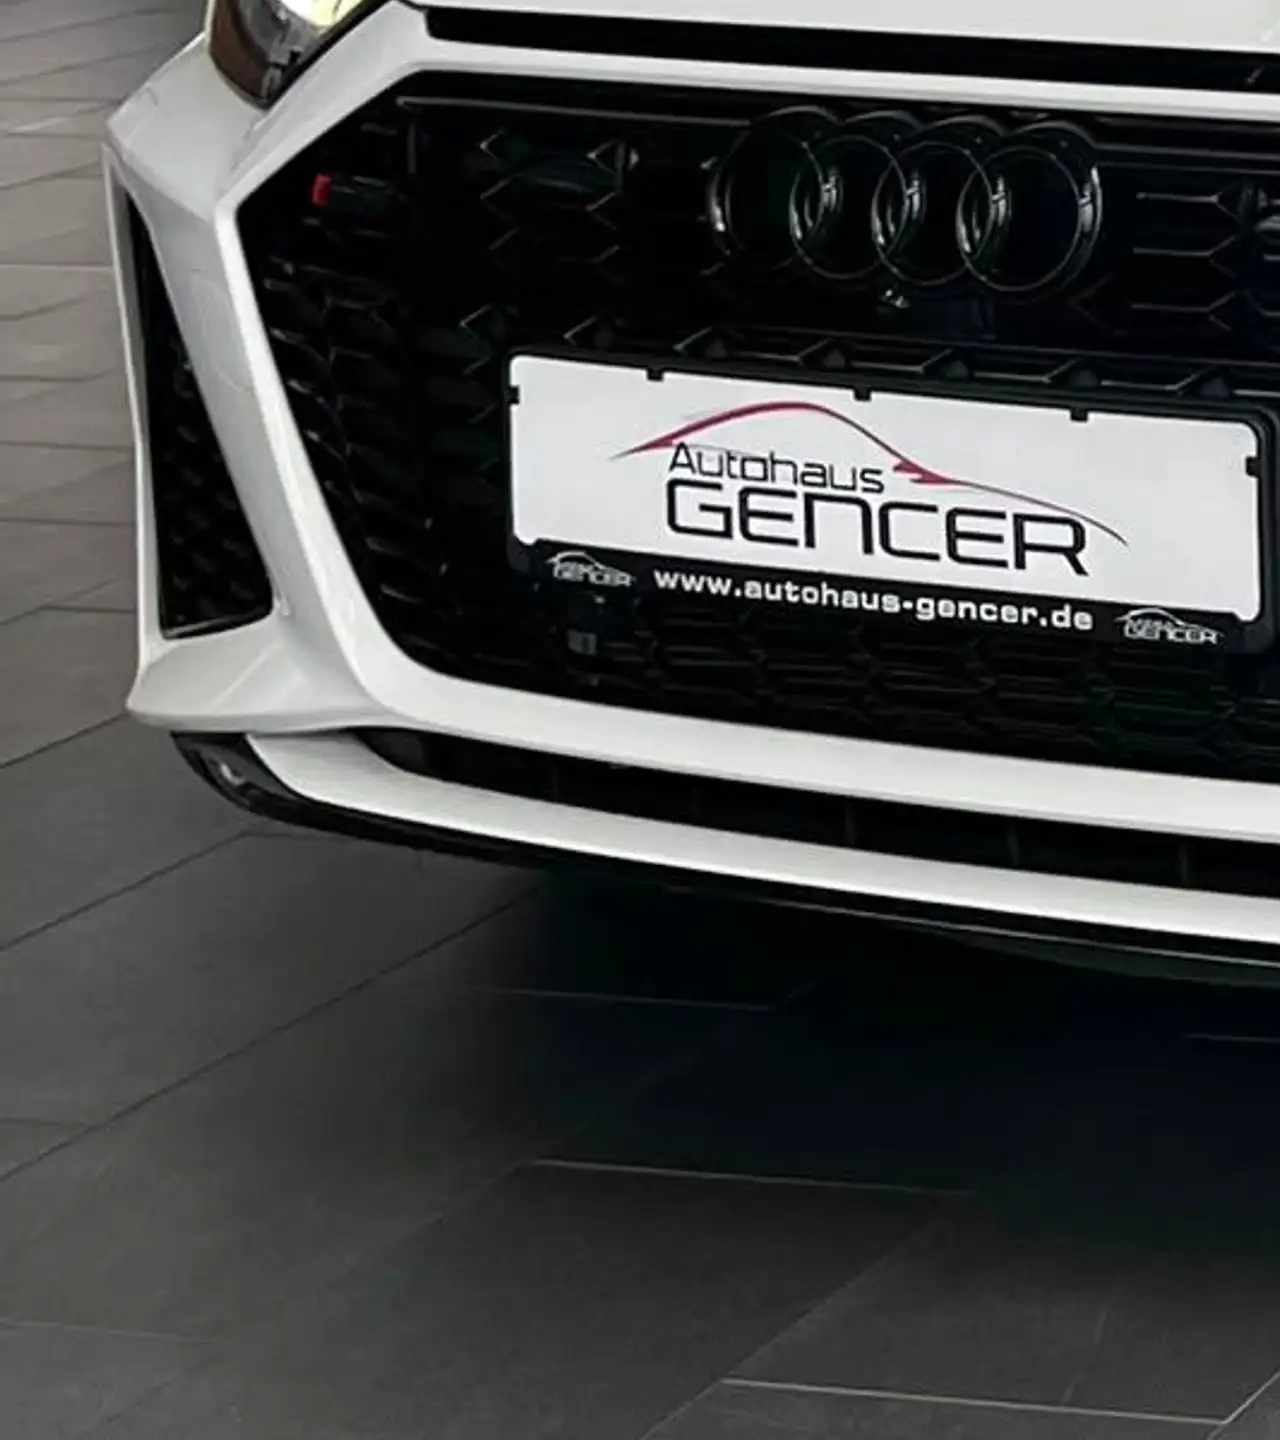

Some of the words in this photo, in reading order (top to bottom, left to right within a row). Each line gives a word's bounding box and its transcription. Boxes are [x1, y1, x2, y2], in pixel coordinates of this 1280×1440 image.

[668, 442, 886, 494] Autohaus
[666, 478, 1089, 576] GENCER
[653, 569, 1094, 629] www.autohaus-gencer.de
